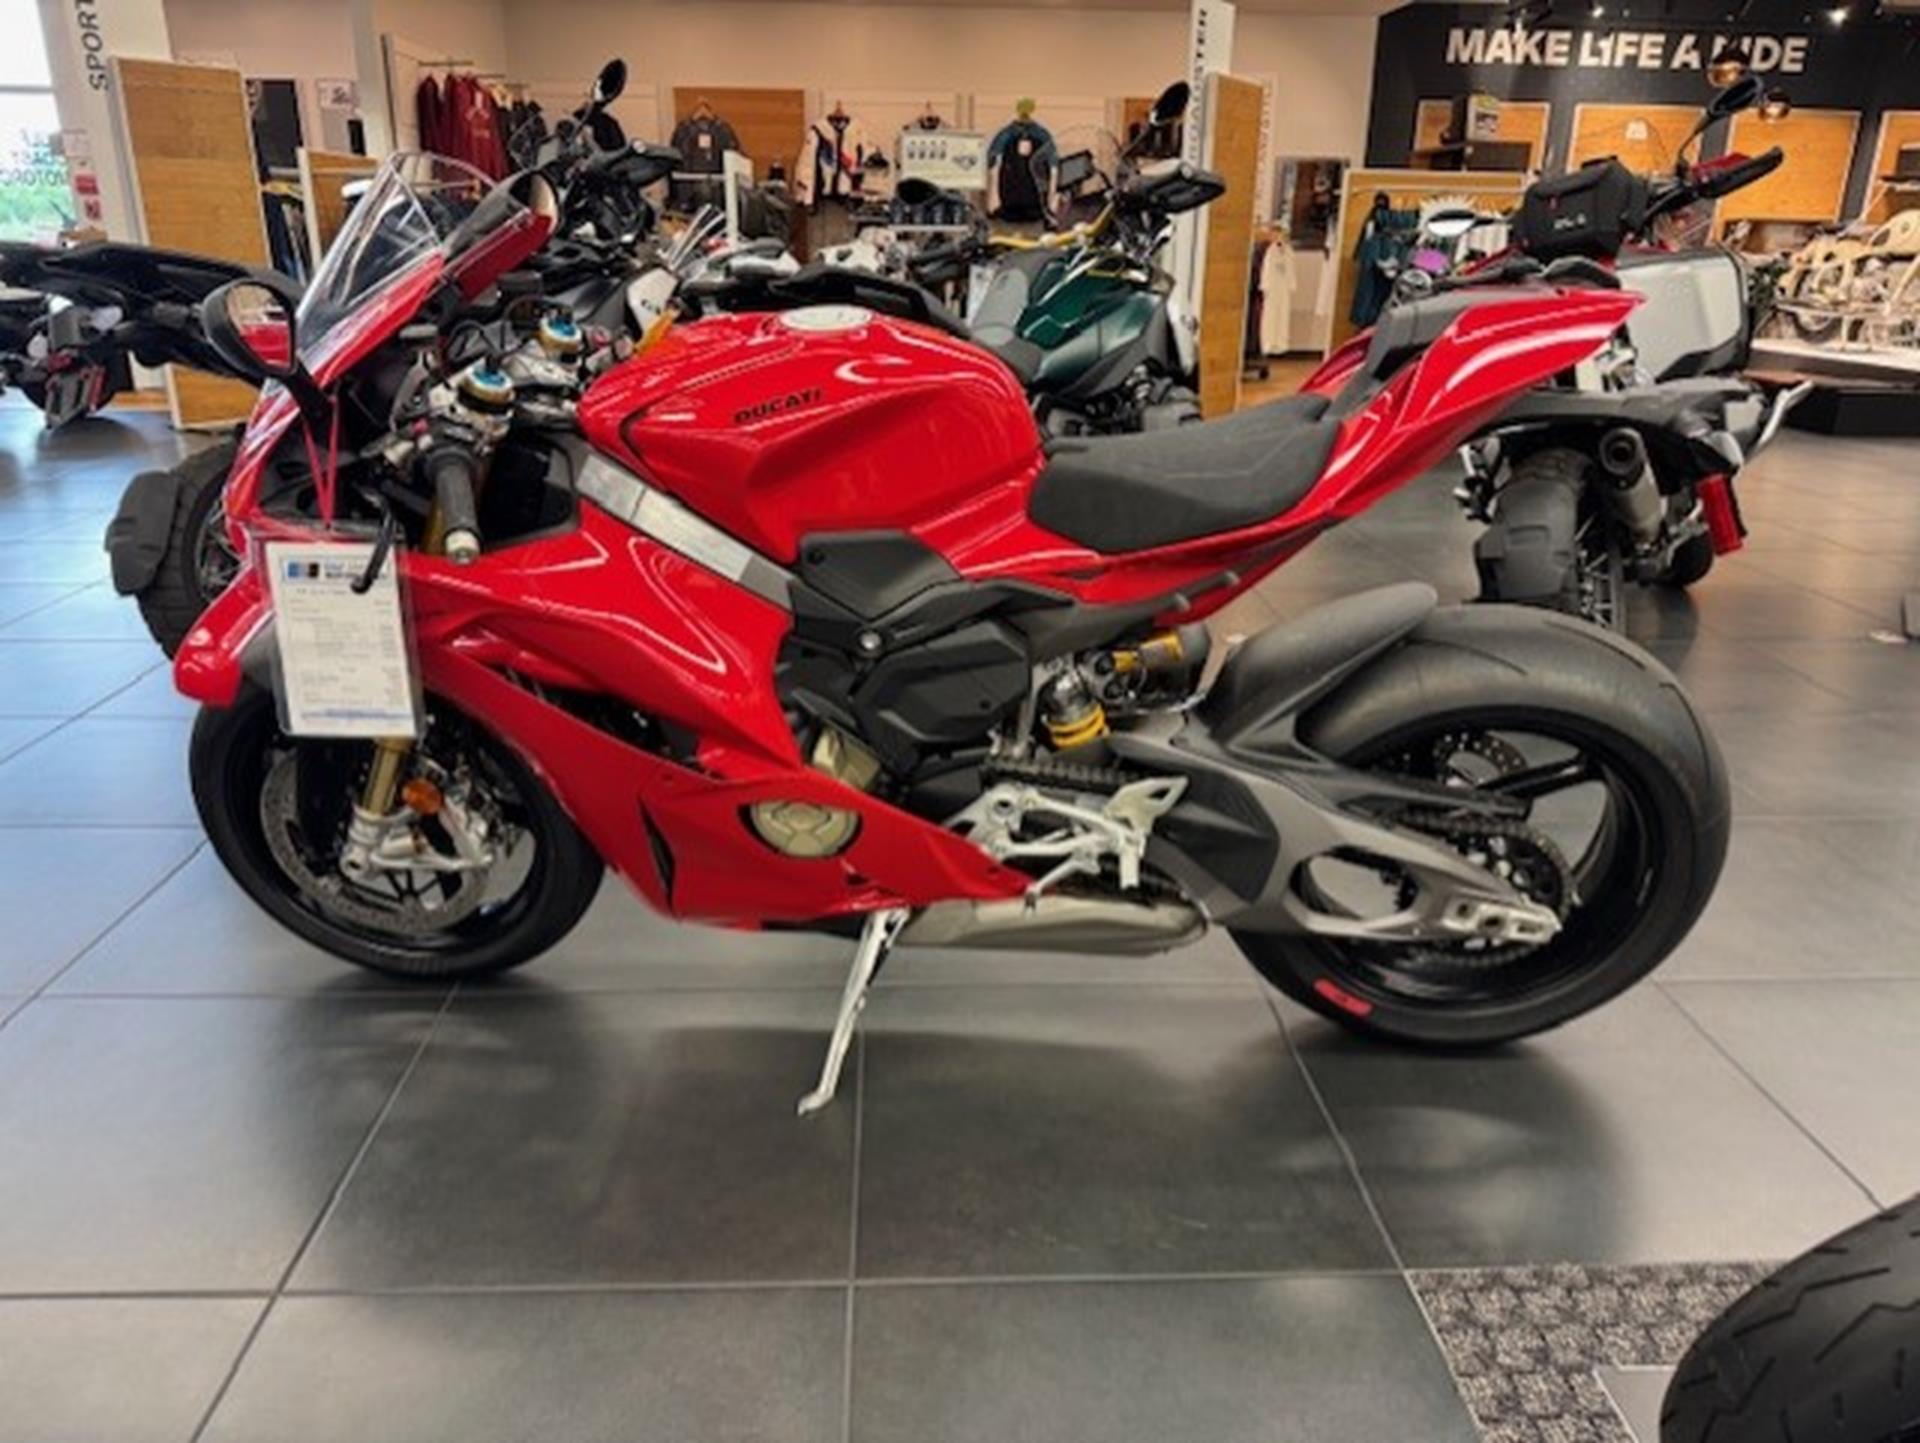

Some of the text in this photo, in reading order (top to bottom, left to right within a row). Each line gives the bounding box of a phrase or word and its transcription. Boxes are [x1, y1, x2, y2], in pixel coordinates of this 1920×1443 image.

[74, 0, 108, 91] SPORT
[1445, 28, 1573, 67] MAKE
[1577, 30, 1666, 69] LIFE
[1670, 33, 1700, 70] A
[734, 387, 821, 424] DUCATI
